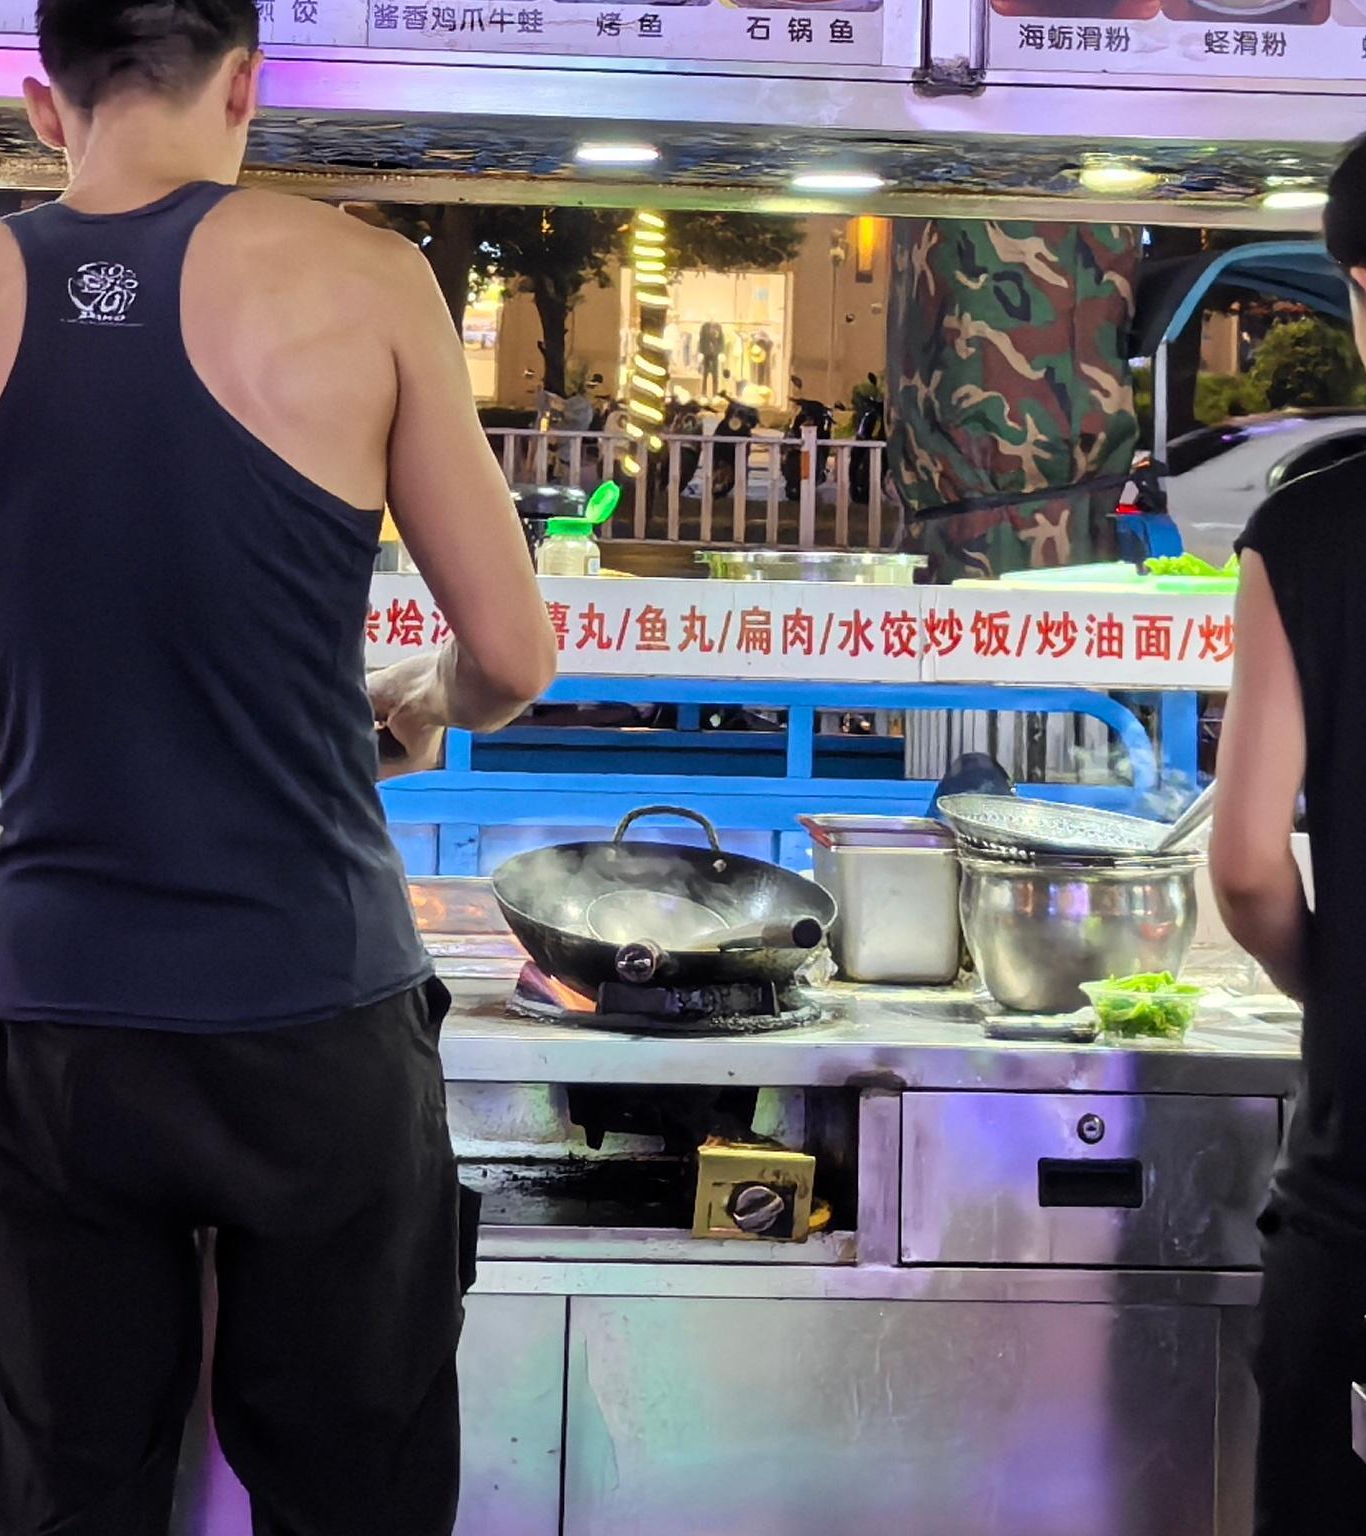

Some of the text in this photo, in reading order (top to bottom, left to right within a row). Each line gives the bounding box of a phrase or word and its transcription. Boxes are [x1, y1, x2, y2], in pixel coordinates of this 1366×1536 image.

[374, 4, 544, 34] 酱香鸡爪牛蛙
[596, 12, 664, 39] 烤鱼
[746, 16, 855, 45] 石锅鱼
[1204, 29, 1287, 57] 蛏滑粉
